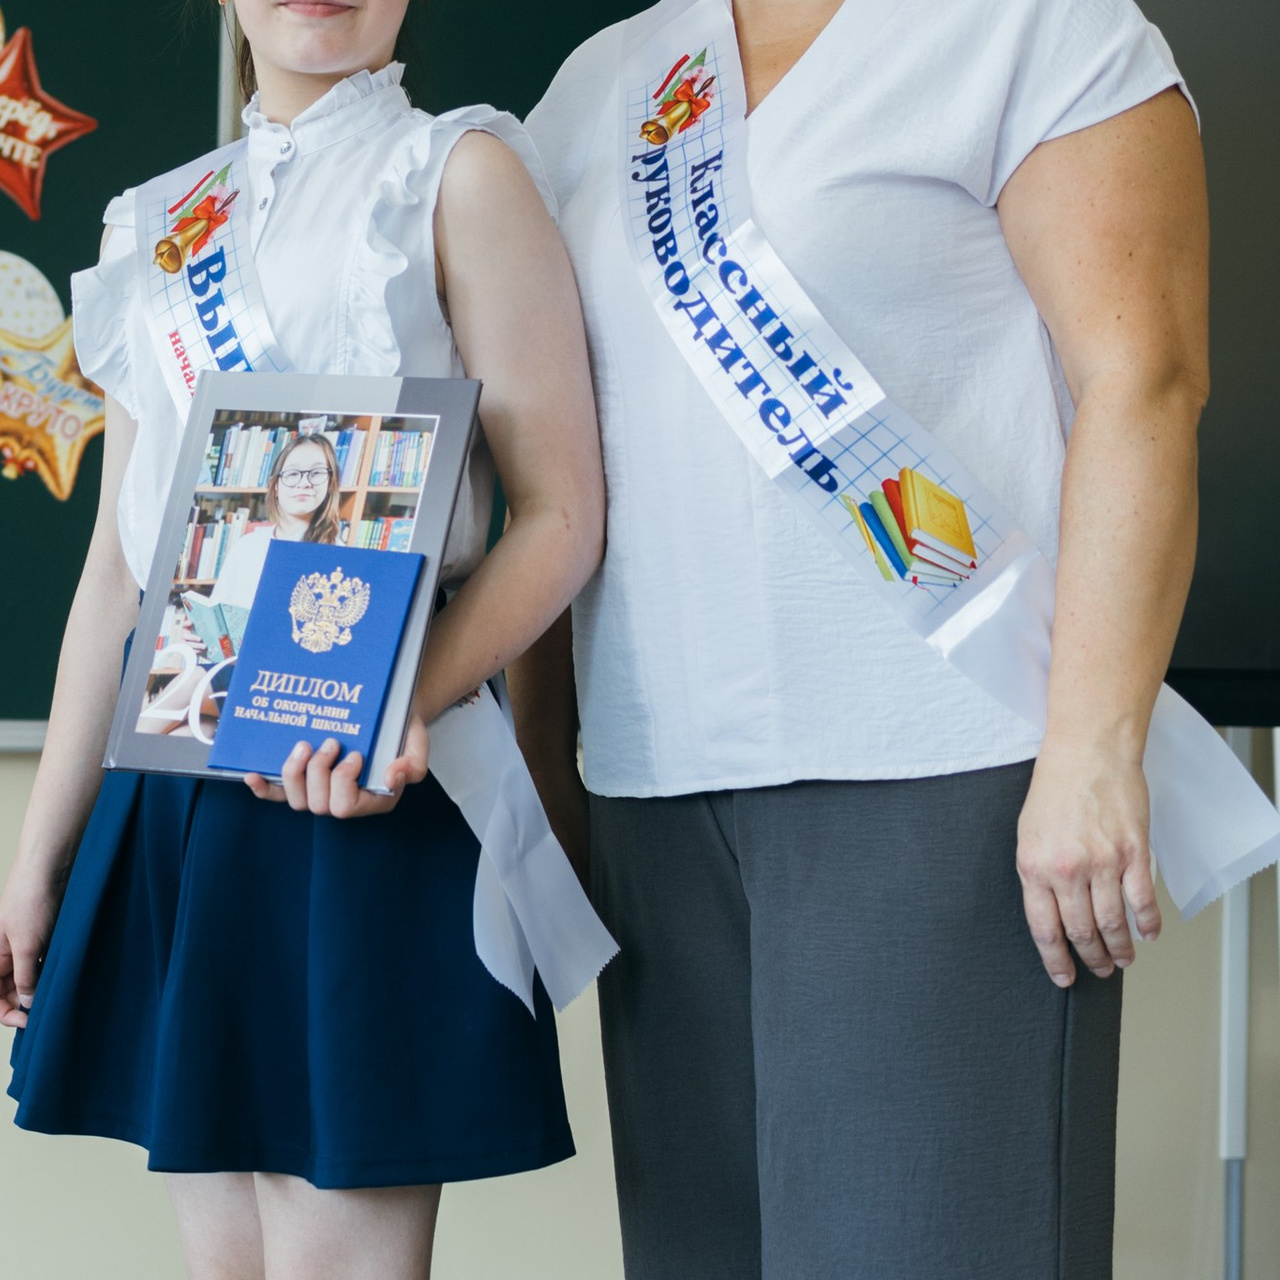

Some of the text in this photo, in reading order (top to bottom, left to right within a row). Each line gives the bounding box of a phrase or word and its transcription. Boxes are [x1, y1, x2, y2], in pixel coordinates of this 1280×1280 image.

[631, 144, 839, 493] руководитель
[249, 669, 363, 704] ДИПЛОМ
[233, 705, 361, 736] НАЧАЛЬНОЙ ШКОЛЫ
[251, 695, 351, 720] ОБ ОКОНЧАНИИ
